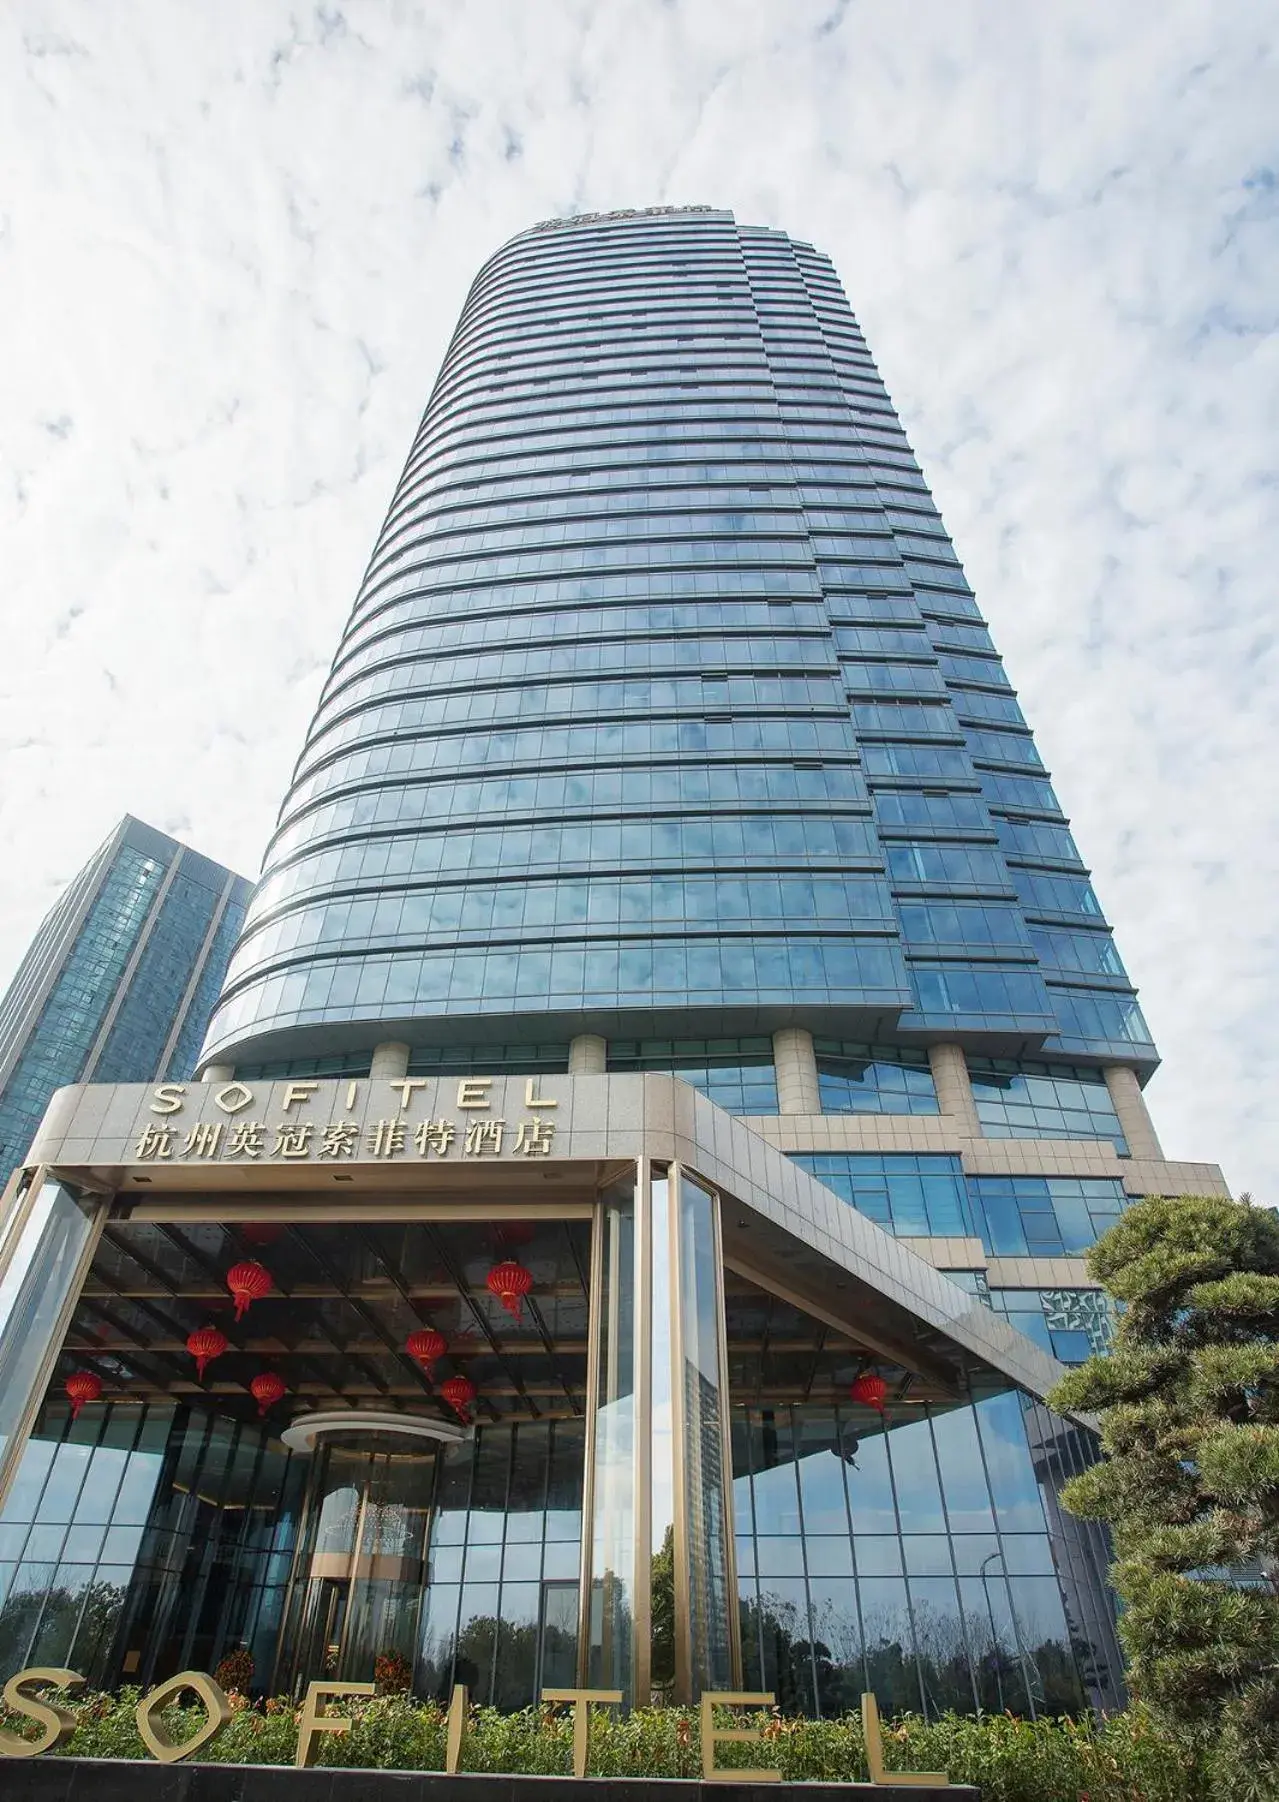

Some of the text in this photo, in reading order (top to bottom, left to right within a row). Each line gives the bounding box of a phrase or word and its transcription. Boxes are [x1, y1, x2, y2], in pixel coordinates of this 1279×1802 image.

[150, 1079, 558, 1114] SOFITEL
[135, 1118, 556, 1158] 杭州英冠索菲特酒店
[0, 1668, 950, 1786] SOFITEL
